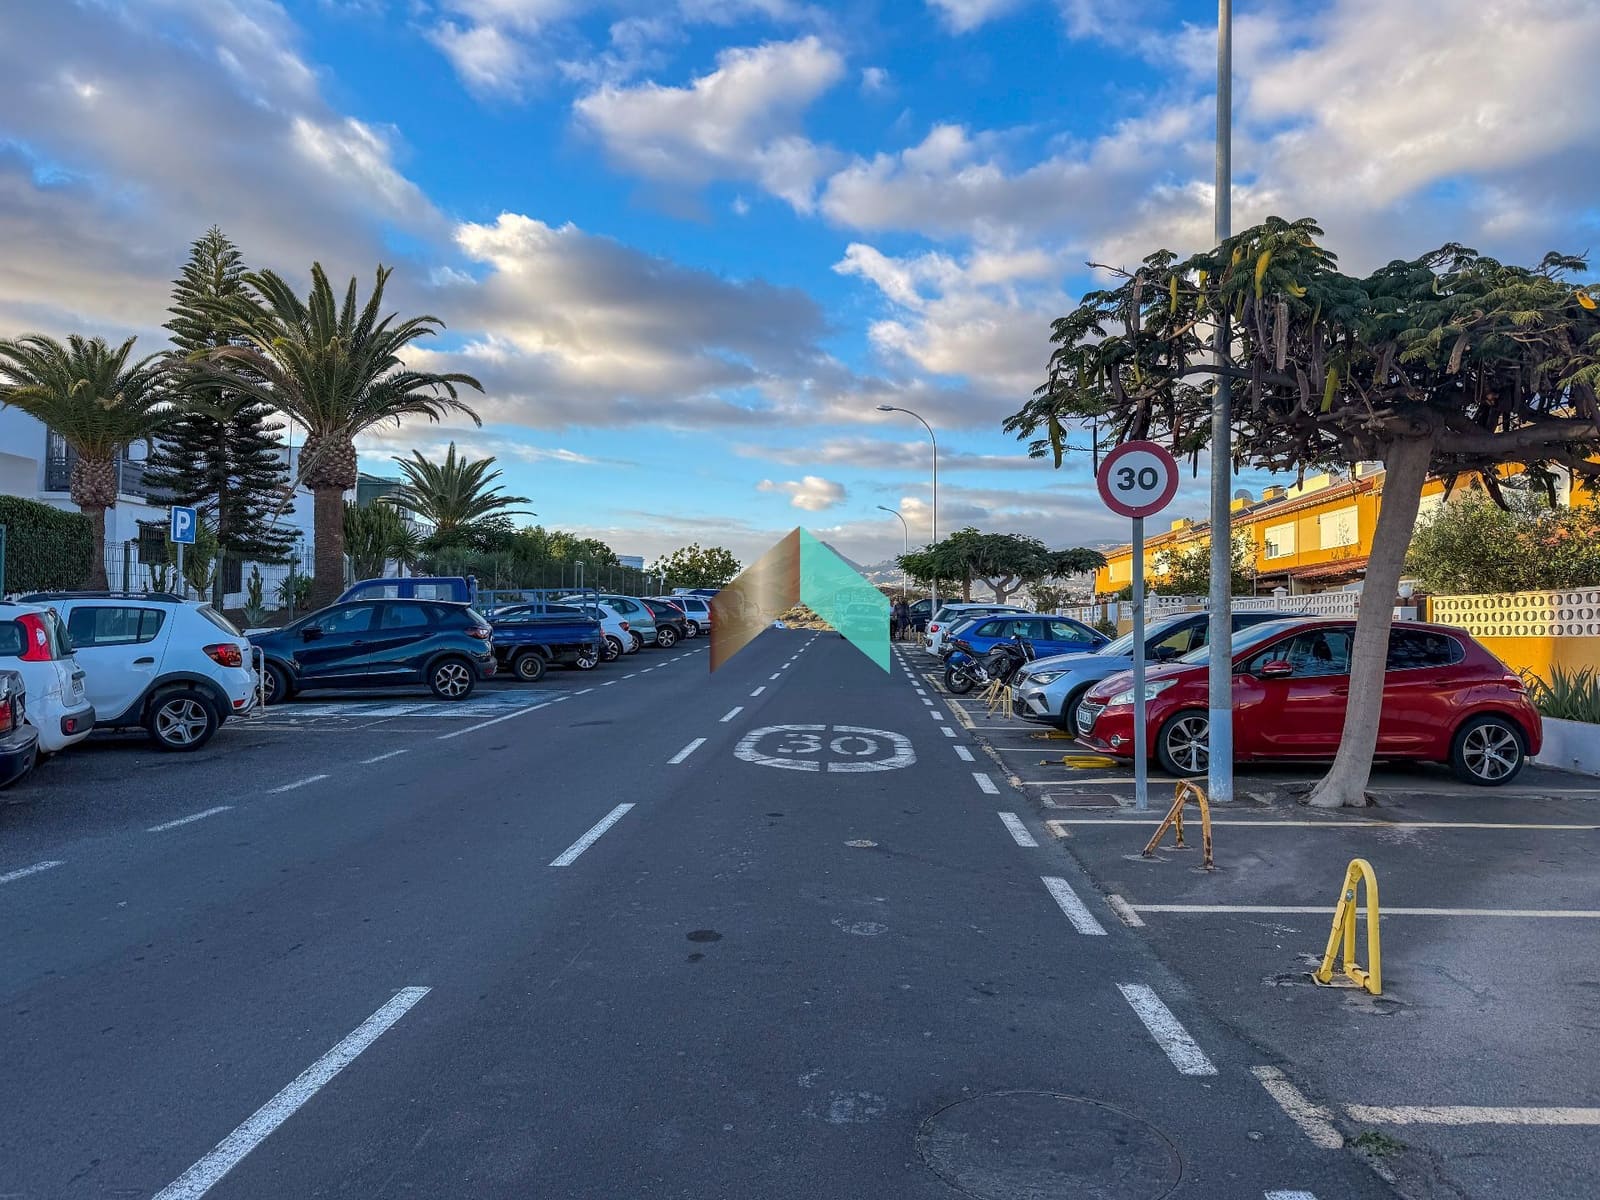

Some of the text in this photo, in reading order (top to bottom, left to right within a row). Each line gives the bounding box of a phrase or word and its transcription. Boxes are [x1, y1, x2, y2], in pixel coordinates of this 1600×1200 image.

[1117, 467, 1158, 491] 30
[177, 510, 191, 538] P
[777, 733, 879, 756] 30
